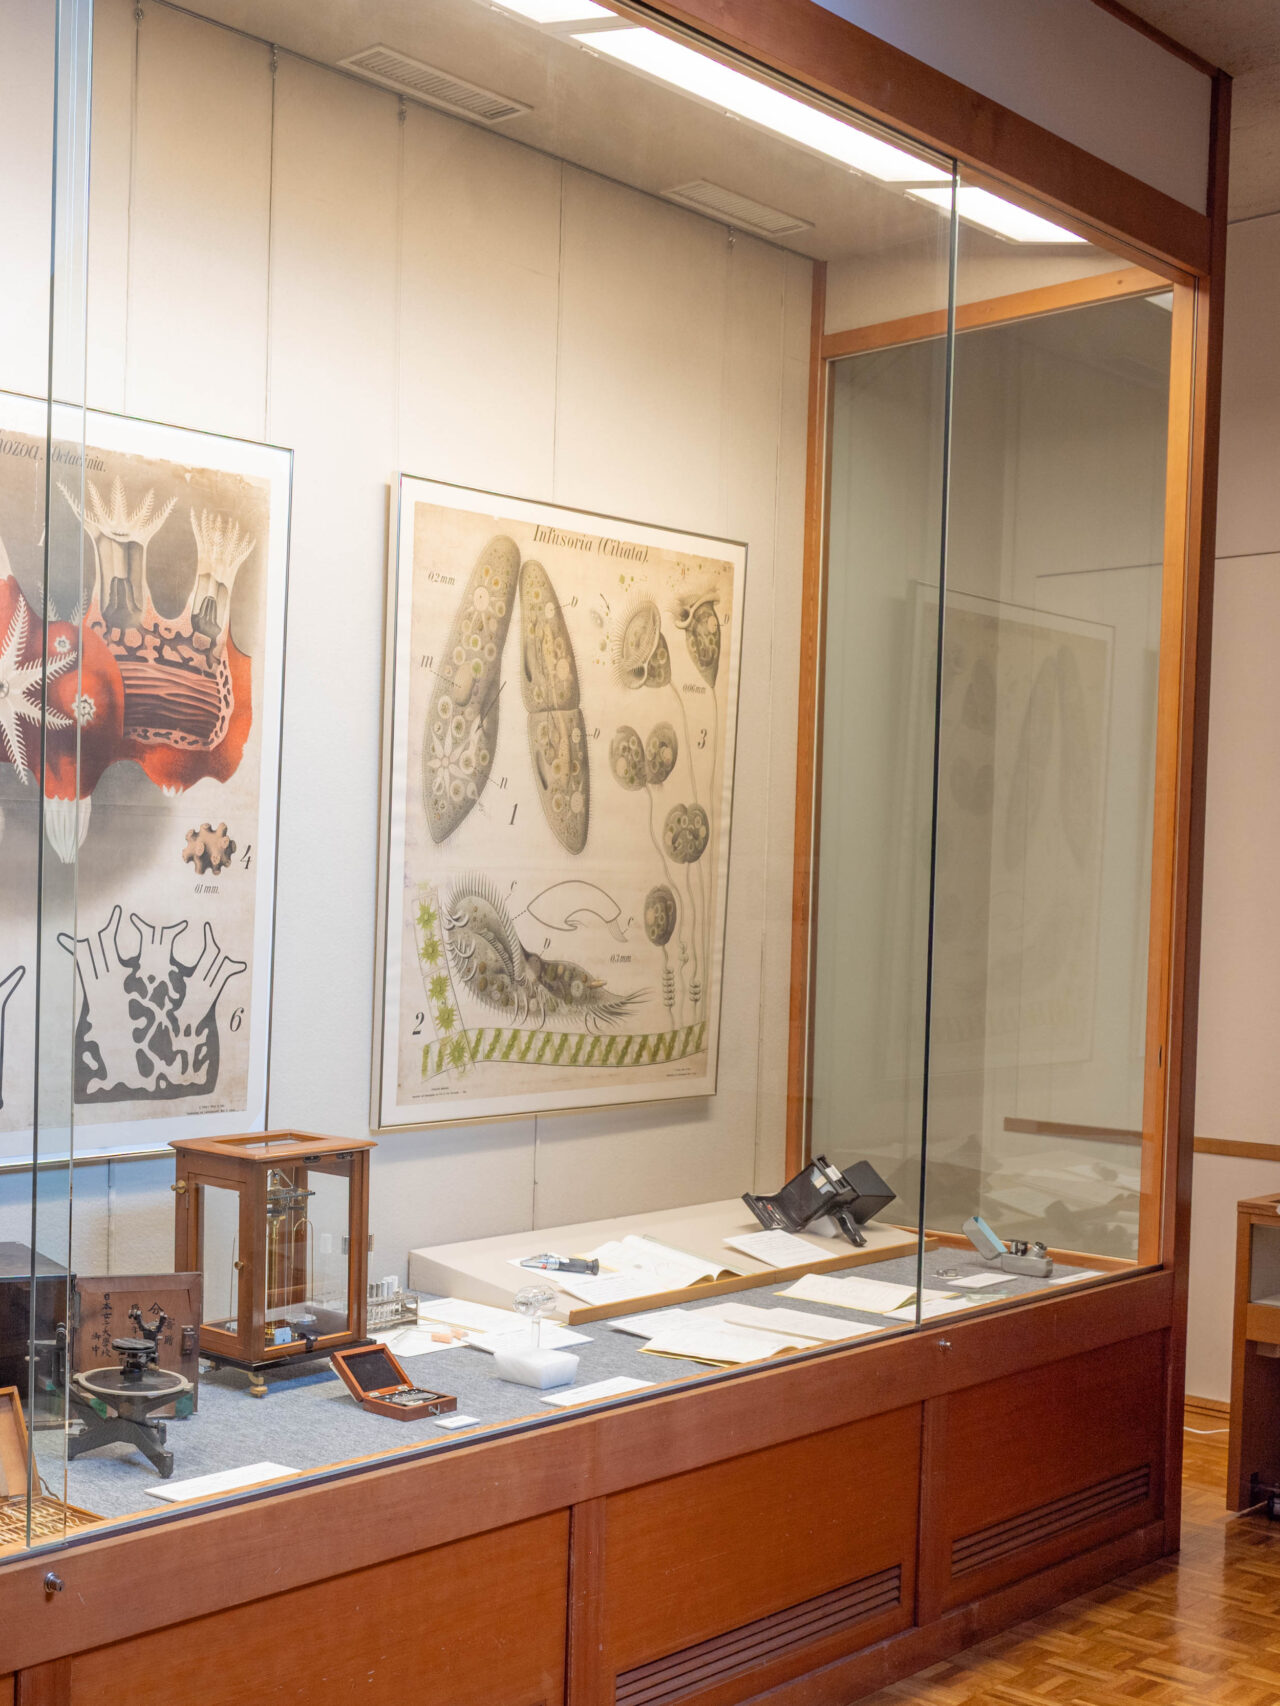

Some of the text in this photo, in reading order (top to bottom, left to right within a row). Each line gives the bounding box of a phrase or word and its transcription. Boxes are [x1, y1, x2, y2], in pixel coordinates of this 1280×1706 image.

[533, 524, 593, 553] Infusoria
[697, 728, 708, 750] 3
[239, 844, 253, 870] 4
[229, 1006, 245, 1034] 6
[412, 1011, 425, 1036] 2
